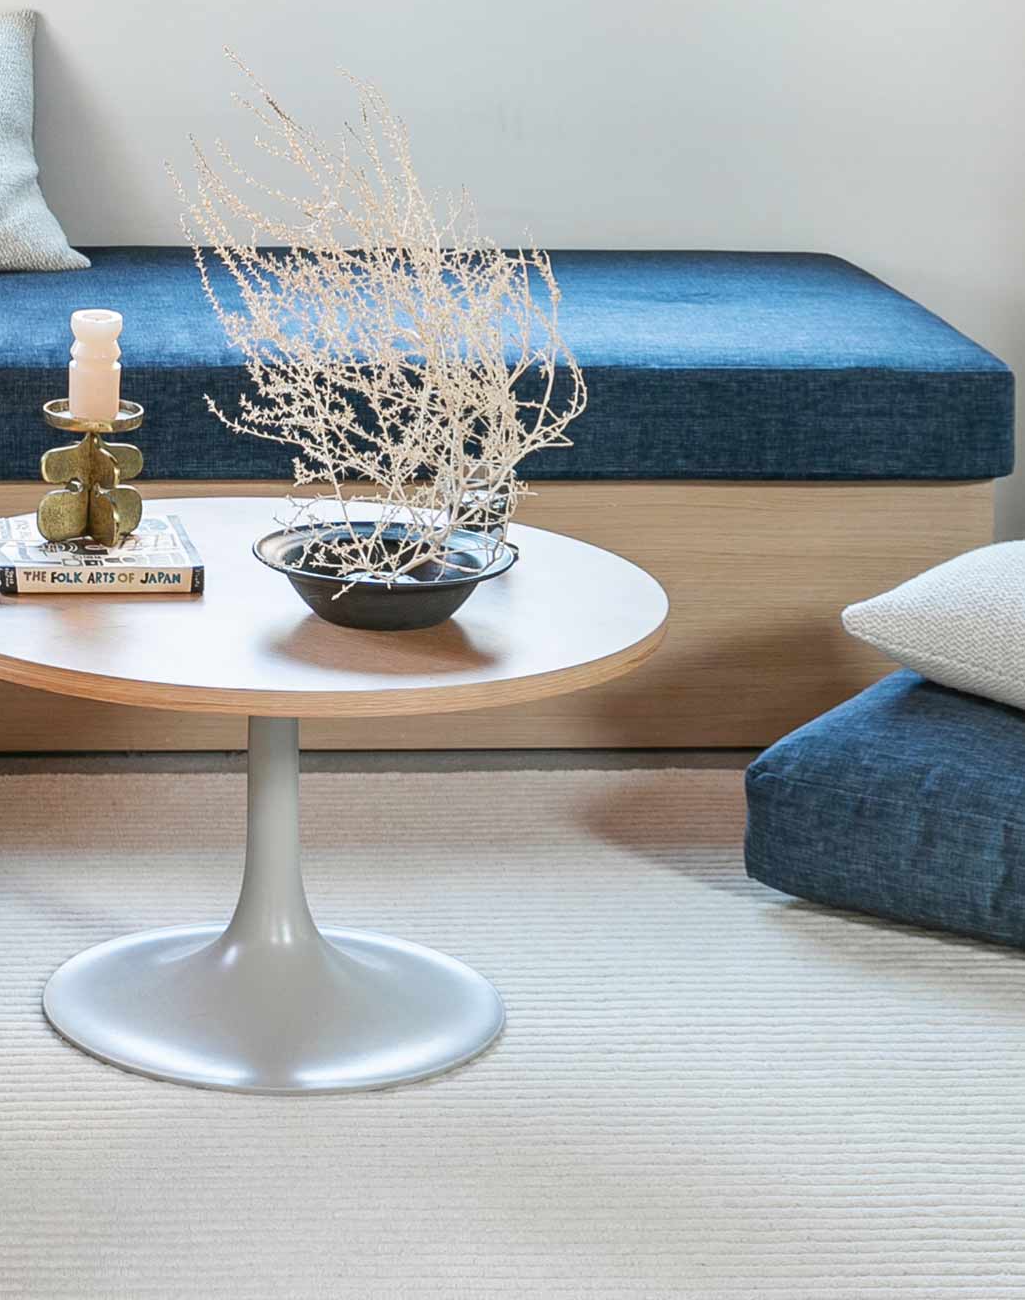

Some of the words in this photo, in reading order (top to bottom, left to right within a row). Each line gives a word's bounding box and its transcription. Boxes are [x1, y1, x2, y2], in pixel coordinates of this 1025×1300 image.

[23, 571, 47, 583] THE
[51, 571, 83, 584] FOLK
[87, 571, 115, 584] ARTS
[118, 572, 135, 583] OF
[140, 572, 181, 584] JAPAN
